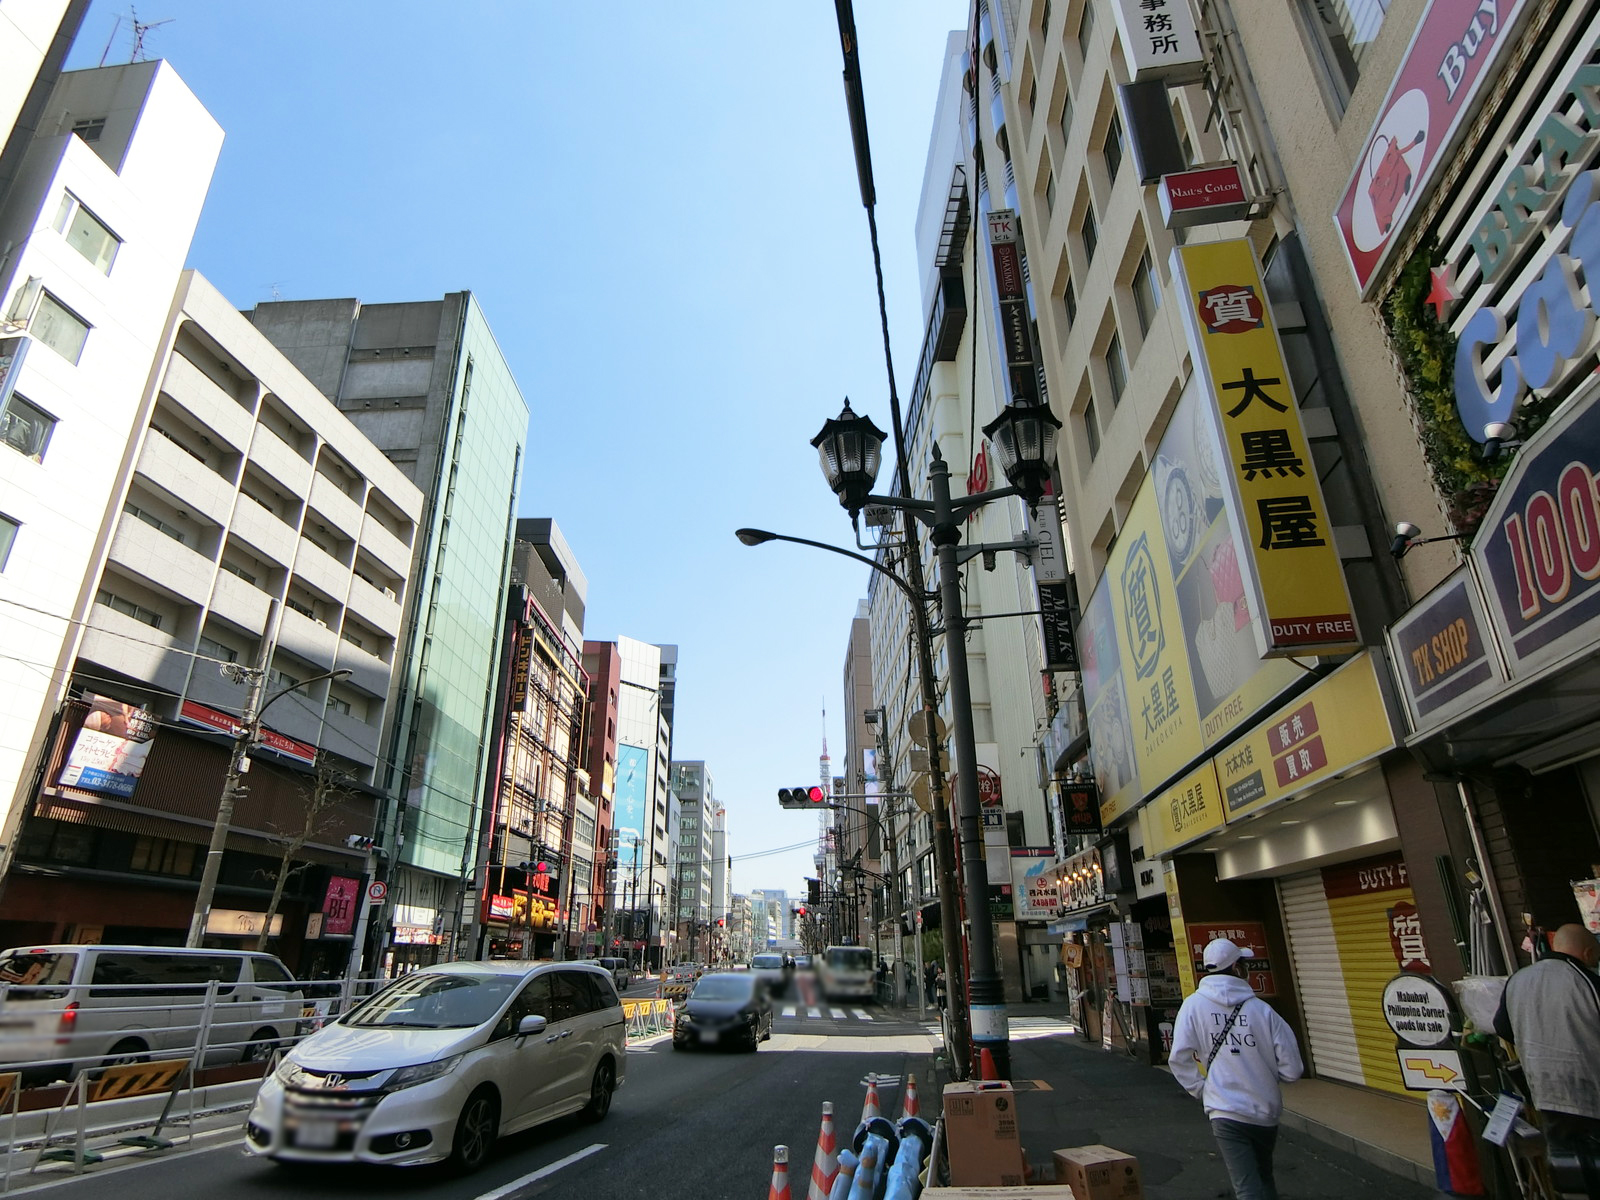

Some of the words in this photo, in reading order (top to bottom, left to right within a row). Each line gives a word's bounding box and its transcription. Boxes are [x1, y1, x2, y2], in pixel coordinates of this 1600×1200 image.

[989, 221, 1012, 233] TK
[1001, 255, 1015, 292] MAXIMUS
[1205, 290, 1260, 328] 質
[1221, 367, 1326, 552] 大黒屋
[1039, 530, 1055, 566] CIEL
[1503, 460, 1600, 621] 100
[1045, 570, 1056, 579] 5F
[1273, 624, 1312, 638] DUTY
[1316, 619, 1354, 634] FREE
[1411, 643, 1435, 686] TK
[1432, 617, 1469, 675] SHOP
[1141, 665, 1180, 741] 大黒屋
[1205, 710, 1224, 738] DUTY
[1224, 695, 1244, 724] FREE
[1278, 714, 1305, 748] 販売
[1225, 744, 1254, 777] 六本木店
[1285, 748, 1313, 780] 買取
[1181, 783, 1206, 819] 大黒屋
[1027, 849, 1040, 857] 11F
[1358, 865, 1394, 890] DUTY
[1392, 913, 1431, 968] 質
[1387, 1004, 1421, 1018] Philippine
[1421, 1006, 1445, 1019] Corner
[1396, 991, 1429, 1004] Mabuhay!
[1210, 1032, 1256, 1047] KING
[1395, 1020, 1415, 1032] goods
[1416, 1020, 1426, 1032] for
[1427, 1021, 1443, 1033] sale
